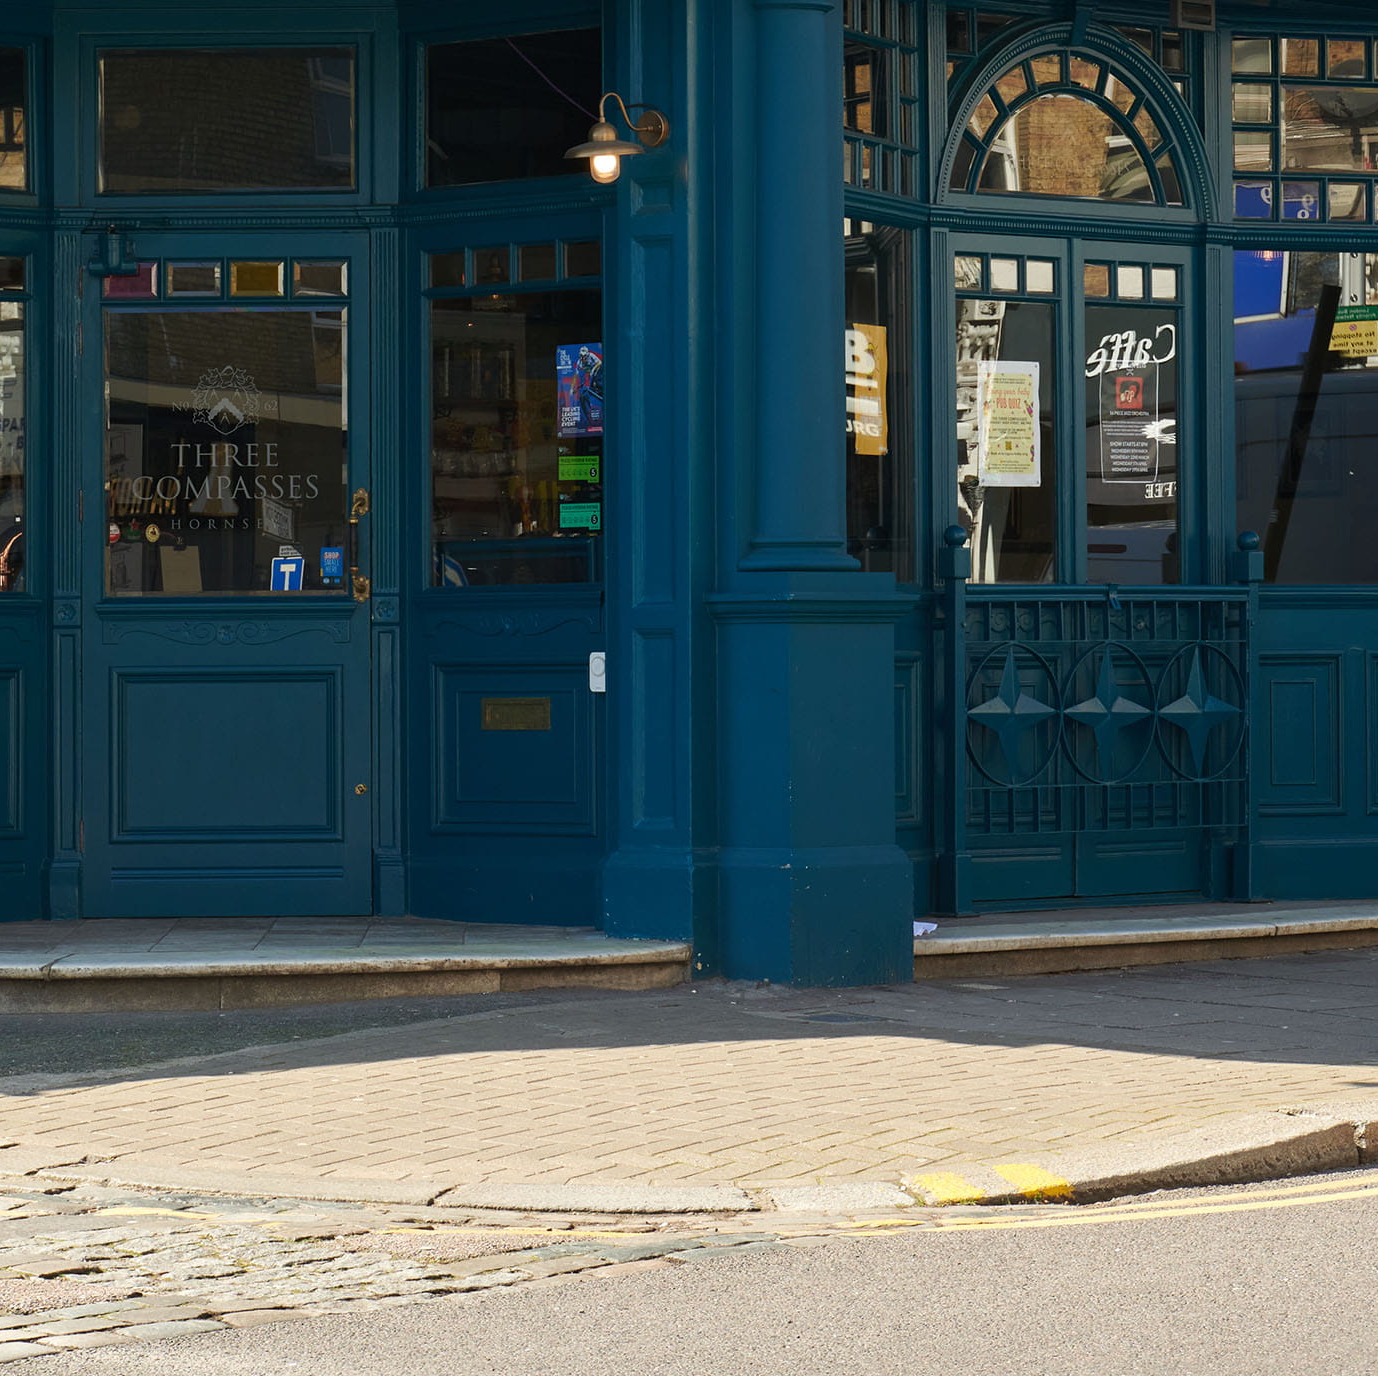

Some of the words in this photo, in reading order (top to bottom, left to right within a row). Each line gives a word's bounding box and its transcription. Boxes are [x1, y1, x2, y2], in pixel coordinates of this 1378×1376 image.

[171, 443, 278, 467] THREE
[132, 474, 319, 501] COMPASSES
[172, 518, 278, 530] HORNSEY
